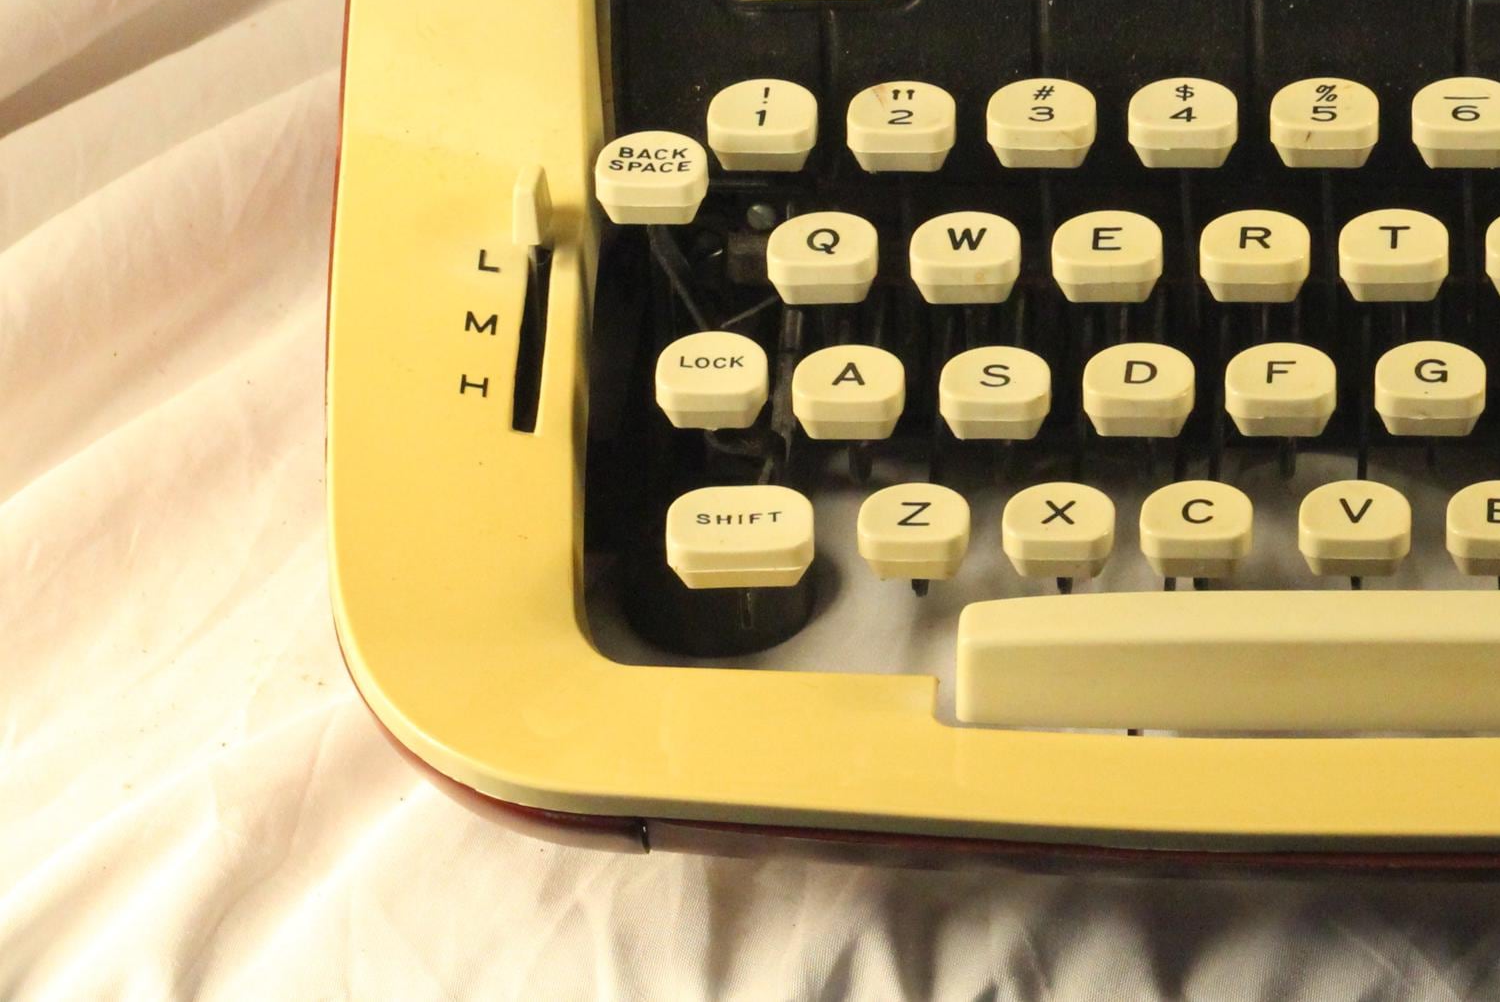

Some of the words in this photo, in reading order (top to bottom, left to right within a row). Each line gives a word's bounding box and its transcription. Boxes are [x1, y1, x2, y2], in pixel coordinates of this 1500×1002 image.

[762, 86, 770, 104] !
[1033, 85, 1055, 101] #
[1175, 84, 1195, 102] $
[1315, 84, 1338, 103] %
[755, 109, 767, 127] 1
[887, 109, 914, 125] 2
[1028, 106, 1055, 123] 3
[1169, 106, 1197, 123] 4
[1311, 105, 1338, 122] 5
[1451, 105, 1481, 122] 6
[618, 146, 688, 161] BACK
[608, 159, 691, 173] SPACE
[806, 228, 841, 255] Q
[947, 227, 988, 251] W
[1091, 227, 1123, 251] E
[1239, 226, 1272, 250] R
[1378, 225, 1411, 250] T
[477, 249, 500, 273] L
[464, 310, 499, 336] M
[679, 355, 744, 369] LOCK
[831, 361, 866, 386] A
[1123, 360, 1158, 385] D
[1266, 360, 1297, 384] F
[1414, 358, 1448, 383] G
[459, 373, 489, 398] H
[979, 364, 1011, 388] S
[696, 511, 781, 525] SHIFT
[897, 501, 932, 527] Z
[1041, 500, 1076, 525] X
[1181, 498, 1214, 525] C
[1339, 497, 1373, 524] V
